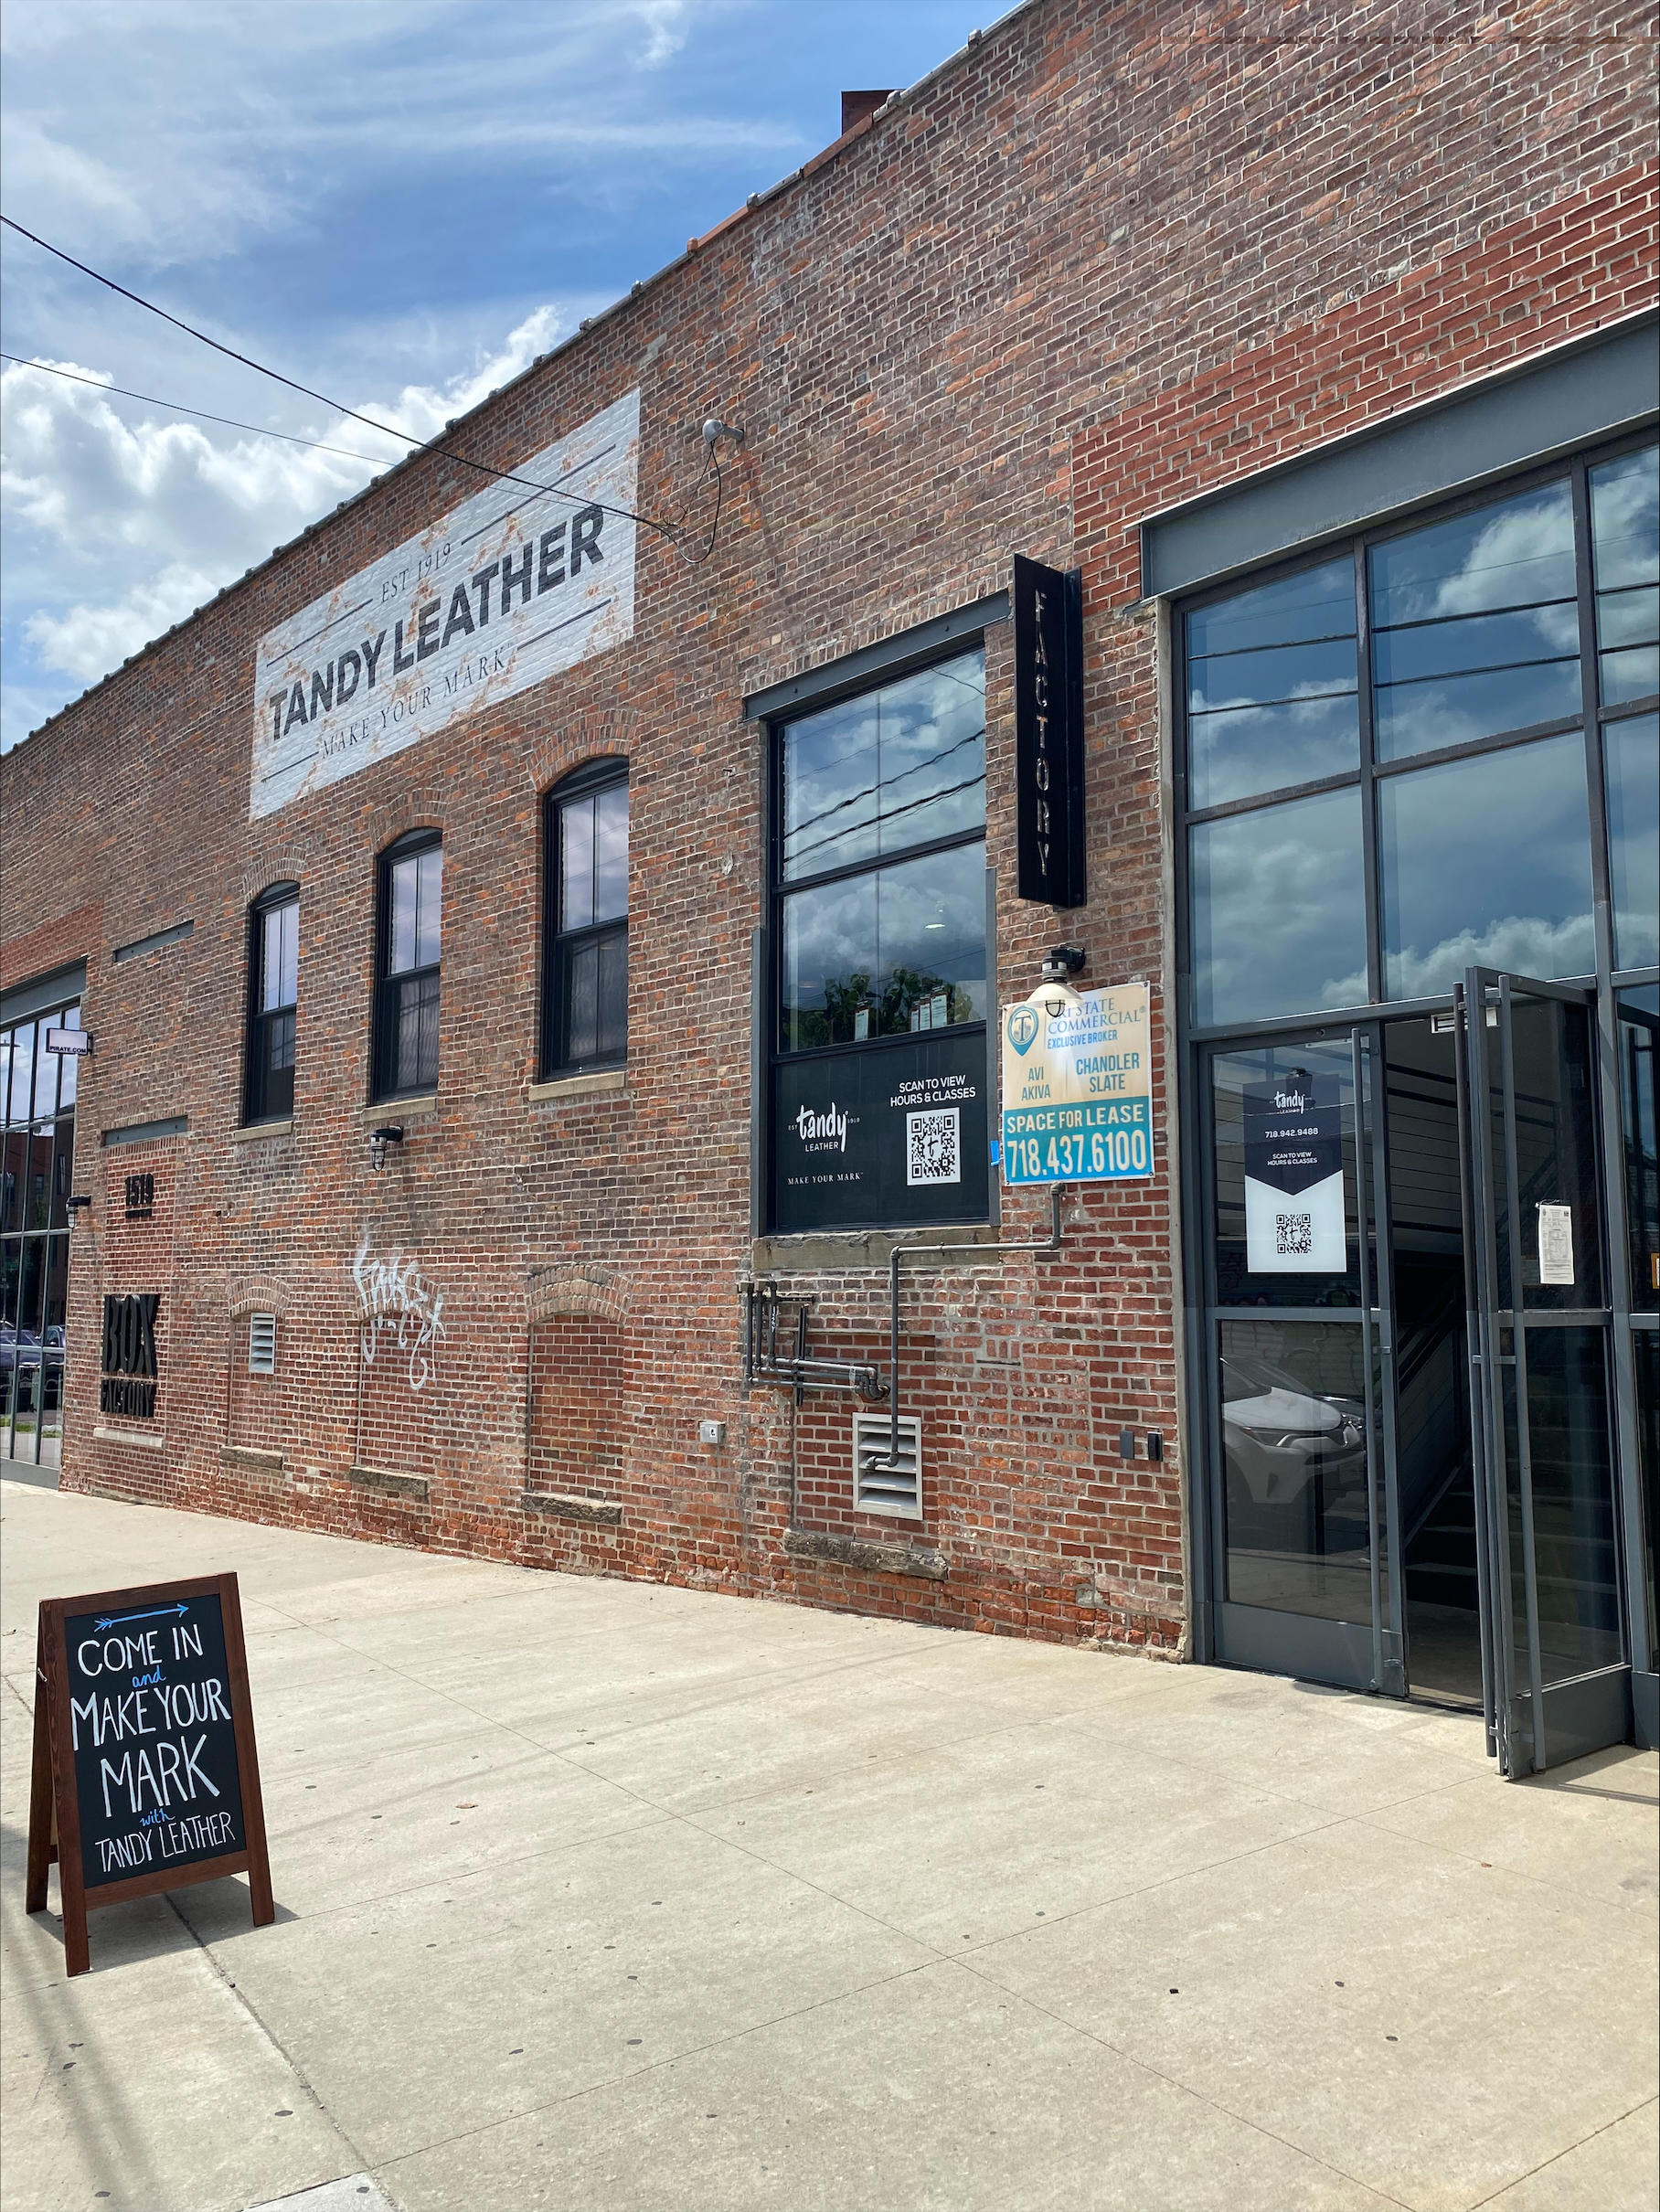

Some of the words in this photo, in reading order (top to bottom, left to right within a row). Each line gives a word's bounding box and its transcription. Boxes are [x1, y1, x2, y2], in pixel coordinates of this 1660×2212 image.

[382, 569, 410, 603] EST
[418, 543, 451, 581] 1919
[270, 629, 388, 741] TANDY
[393, 505, 605, 675] LEATHER
[322, 718, 370, 760] MAKE
[380, 686, 431, 728] YOUR
[1035, 588, 1050, 877] FACTORY
[1047, 1033, 1086, 1049] EXCLUSIVE
[1087, 1029, 1118, 1044] BROKER
[1027, 1067, 1044, 1082] AVI
[1076, 1052, 1140, 1076] CHANDLER
[890, 1093, 923, 1107] HOURS
[924, 1092, 931, 1103] &
[932, 1087, 976, 1102] CLASSES
[899, 1079, 925, 1093] SCAN
[925, 1079, 939, 1090] TO
[940, 1075, 966, 1088] VIEW
[1021, 1084, 1051, 1101] AKIVA
[1090, 1073, 1126, 1093] SLATE
[1274, 1090, 1304, 1114] tandy
[796, 1101, 846, 1153] tandy
[1006, 1111, 1056, 1134] SPACE
[1059, 1109, 1082, 1129] FOR
[1086, 1104, 1144, 1126] LEASE
[805, 1141, 839, 1152] LEATHER
[1006, 1129, 1146, 1178] 718.437.6100
[787, 1176, 809, 1186] MAKE
[812, 1175, 834, 1184] YOUR
[101, 1293, 160, 1379] BOX
[101, 1379, 157, 1418] FACTORY
[78, 1630, 163, 1676] COME
[172, 1623, 204, 1661] IN
[132, 1664, 167, 1689] and
[70, 1689, 156, 1751] MAKE
[153, 1678, 231, 1731] YOUR
[101, 1733, 220, 1818] MARK
[139, 1807, 176, 1827] with
[95, 1829, 154, 1873] TANDY
[159, 1812, 237, 1858] LEATHER
